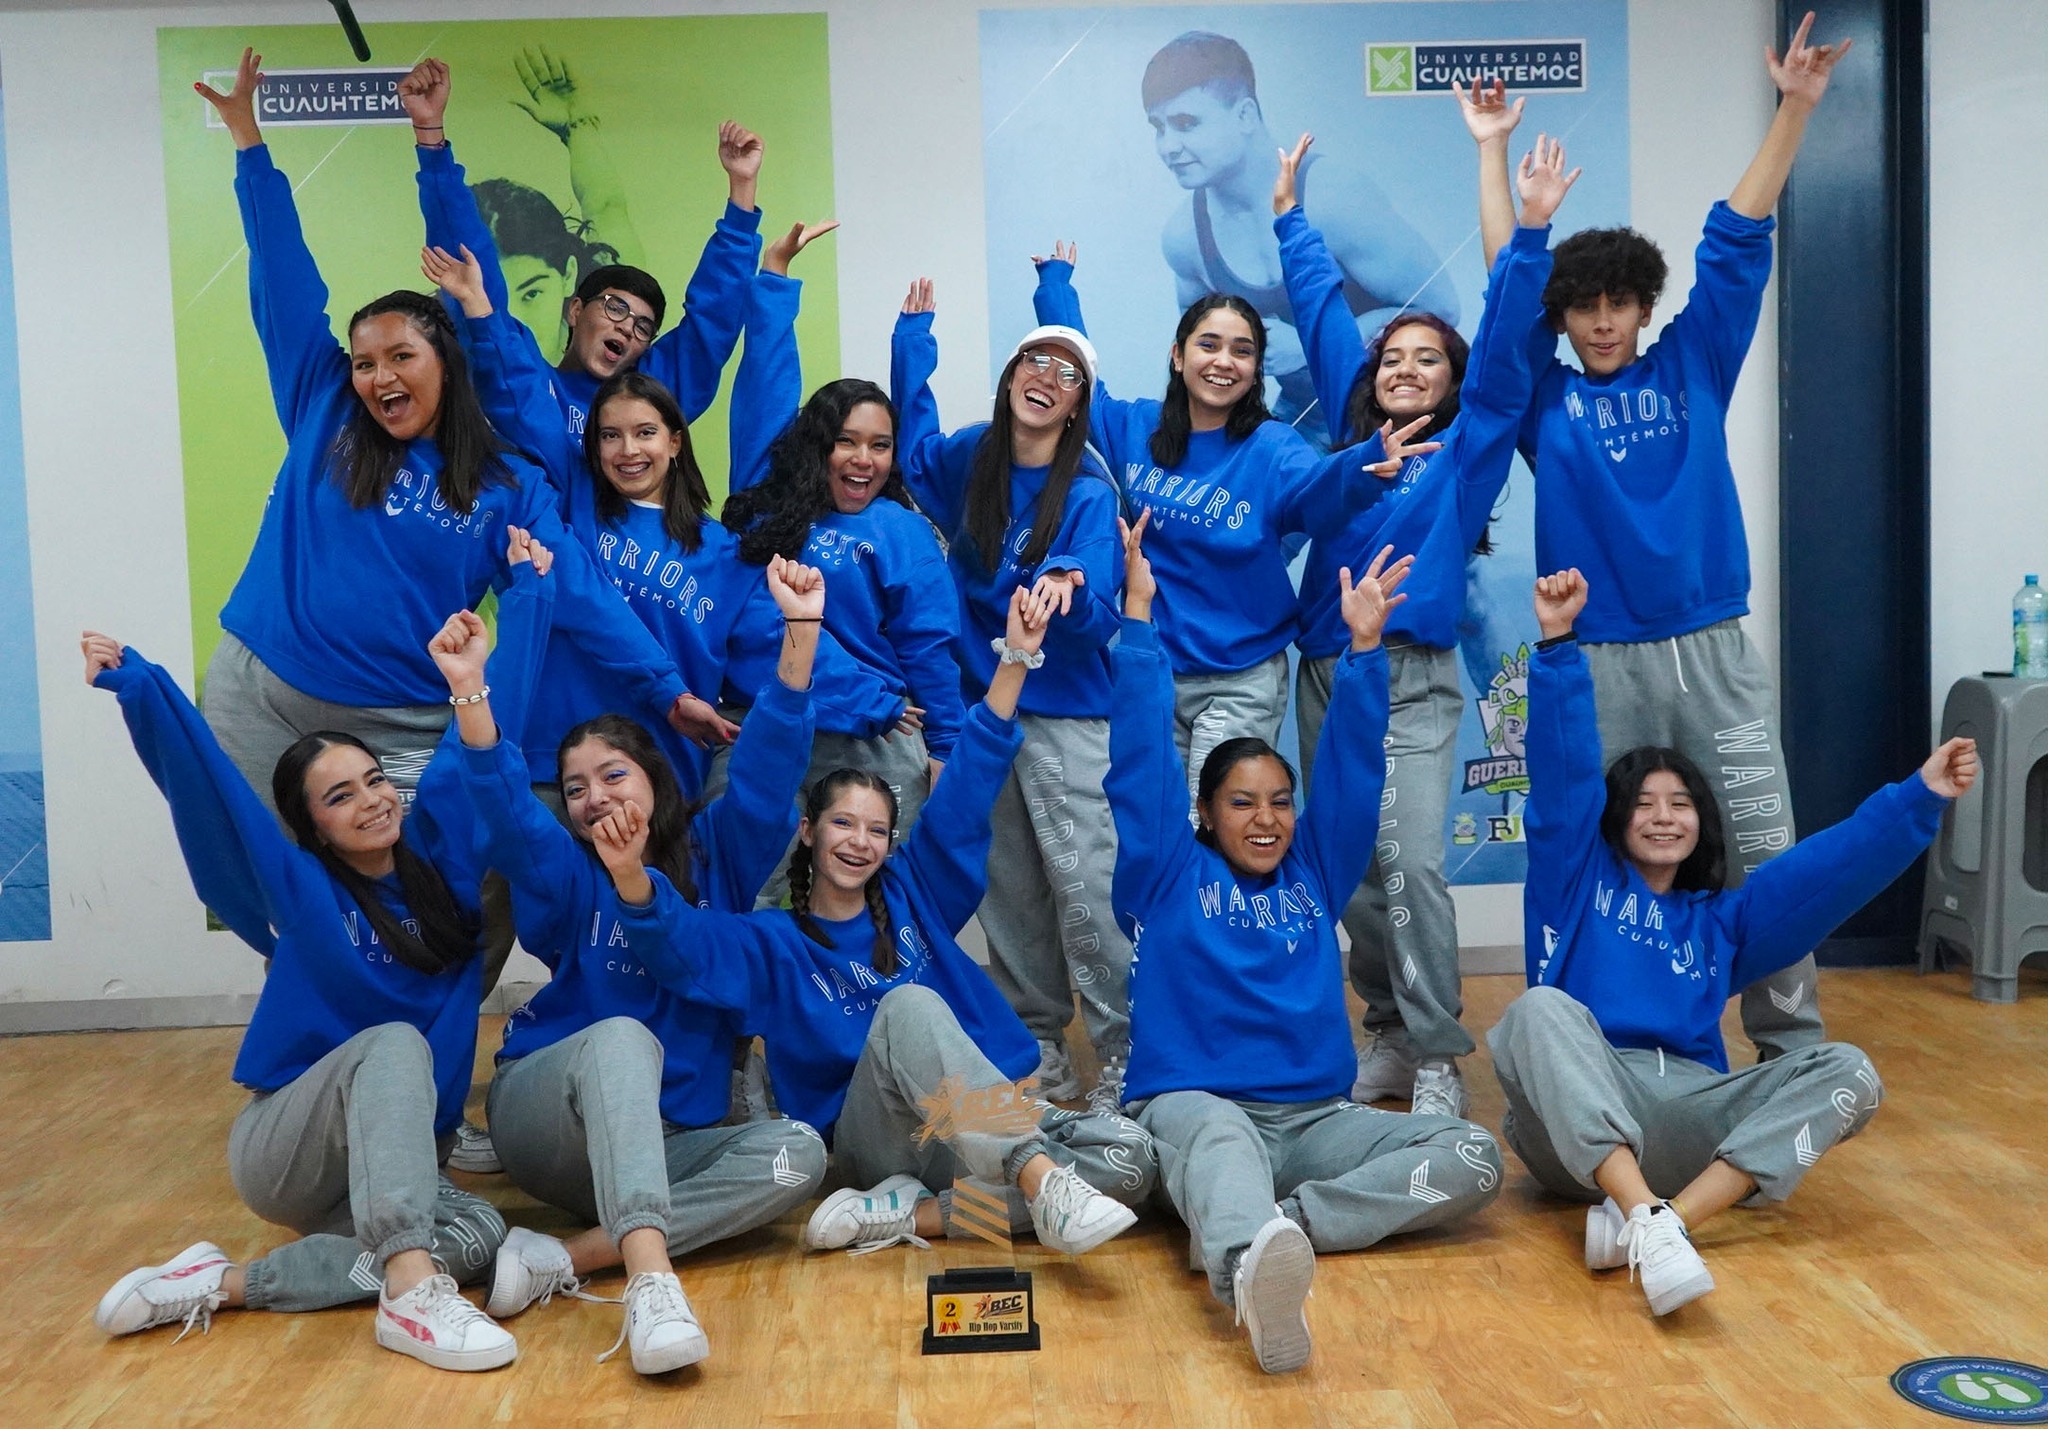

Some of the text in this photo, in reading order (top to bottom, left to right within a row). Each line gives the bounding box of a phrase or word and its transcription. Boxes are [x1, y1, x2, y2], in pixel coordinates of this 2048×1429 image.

[1418, 50, 1579, 65] UNIVERSIDAD
[261, 80, 397, 96] UNIVERSID
[262, 93, 406, 114] CUAUHTEM
[598, 530, 714, 624] RRIORS
[613, 577, 688, 616] HTÉMOC
[945, 1302, 957, 1318] 2
[990, 1295, 1022, 1313] BEC
[969, 1320, 1023, 1333] Hip Hop Varsity
